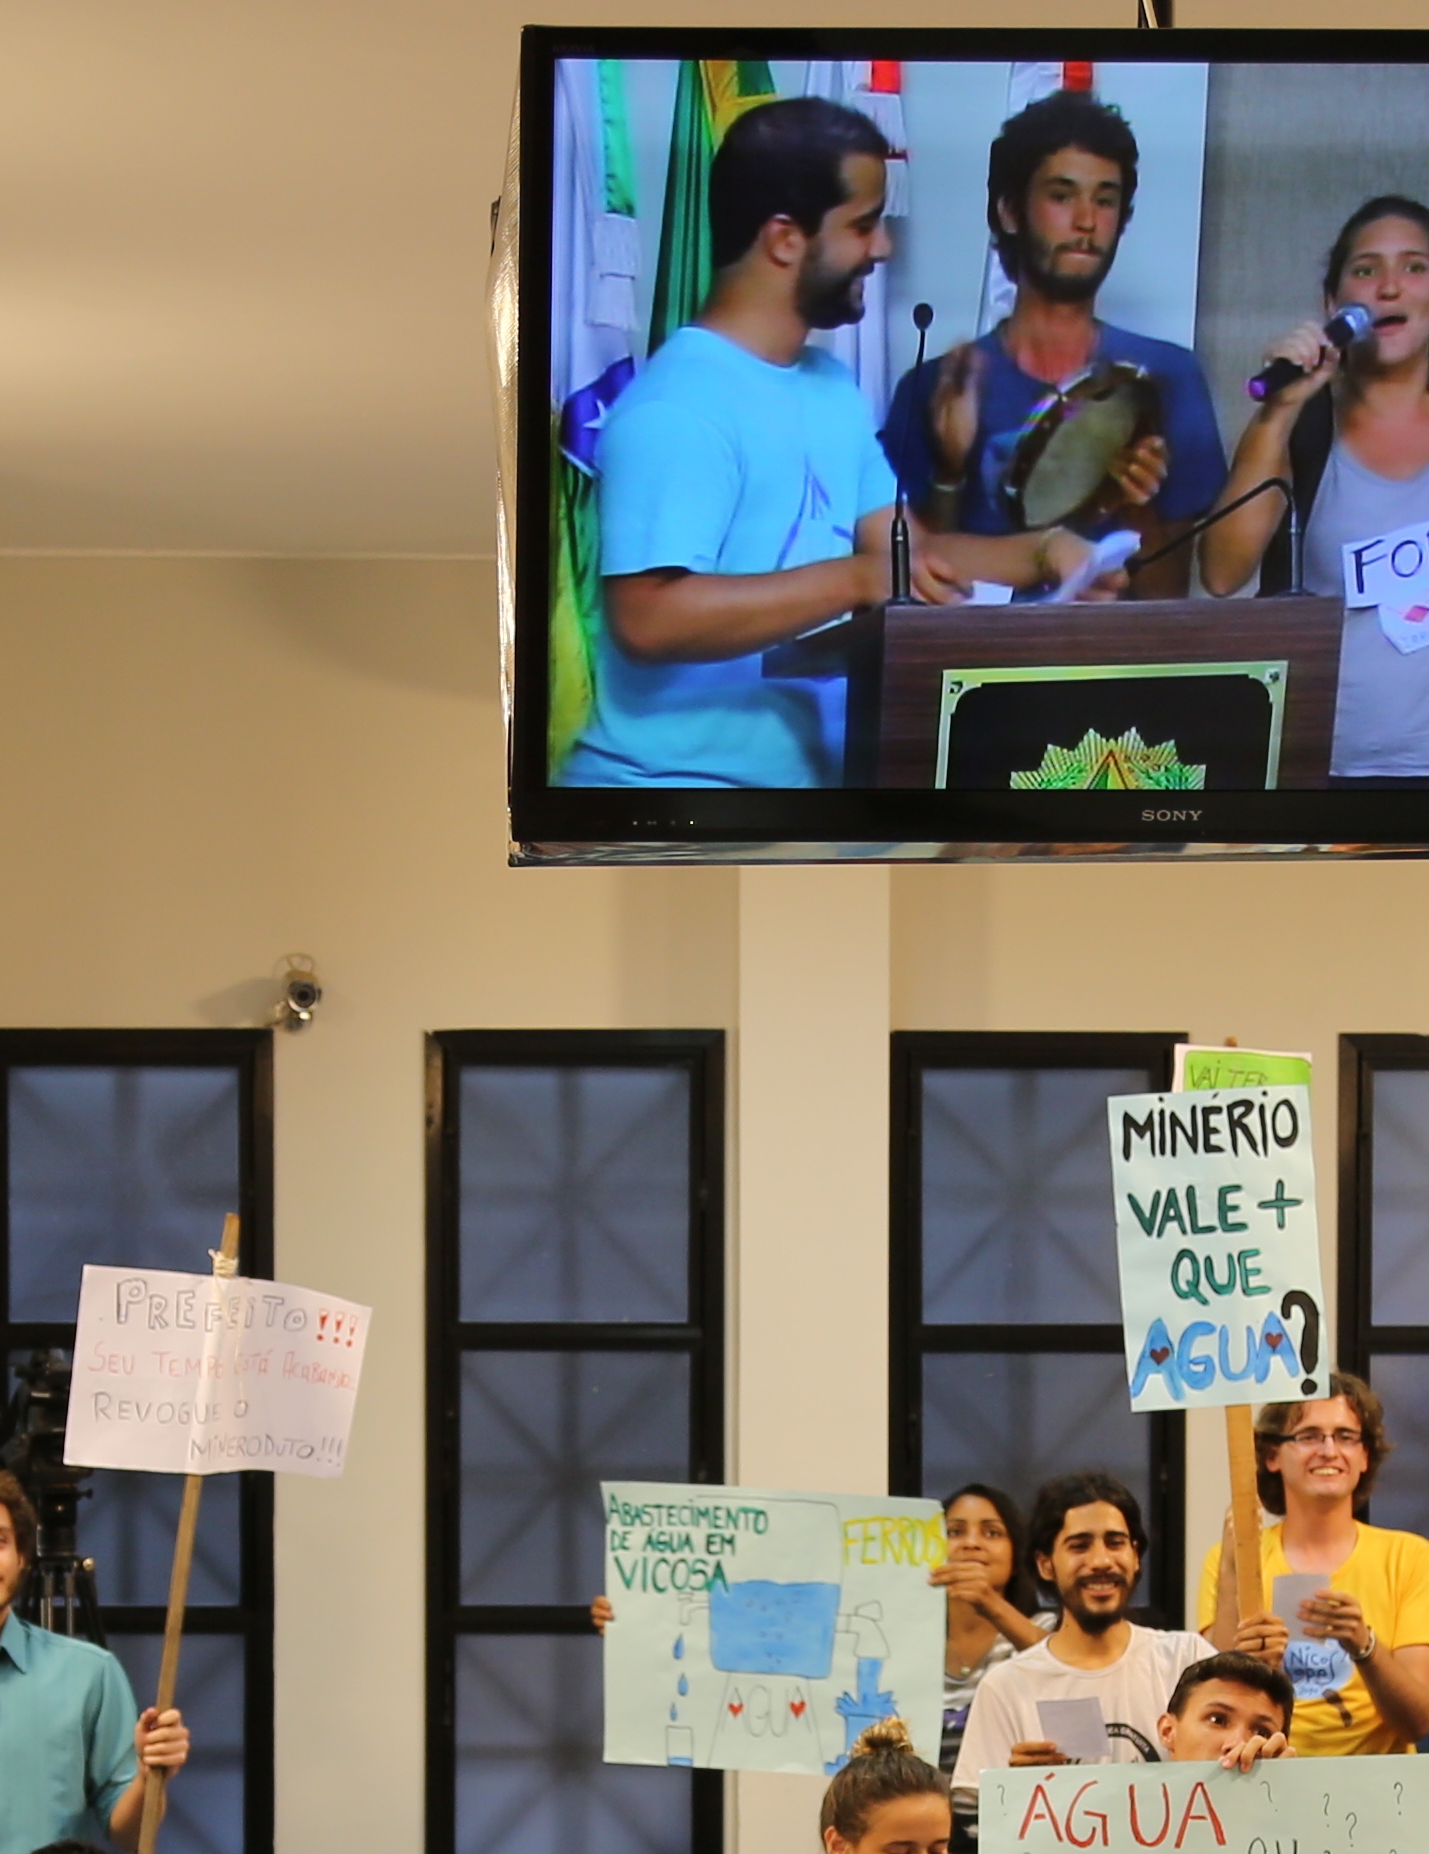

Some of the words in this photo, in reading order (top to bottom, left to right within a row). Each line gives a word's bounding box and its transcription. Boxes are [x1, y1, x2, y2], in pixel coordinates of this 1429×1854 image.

[1142, 809, 1203, 822] SONY
[1122, 1090, 1299, 1161] MINÉRIO
[1127, 1184, 1249, 1238] VALE
[1171, 1248, 1272, 1306] QUE
[88, 1341, 136, 1375] SEU
[153, 1350, 224, 1381] TEMPO
[93, 1390, 220, 1425] REVOGUE
[234, 1400, 249, 1419] O
[606, 1493, 769, 1535] ABASTECIMENTO
[610, 1529, 630, 1552] DE
[706, 1535, 736, 1556] EM
[1018, 1772, 1228, 1849] ÁGUA
